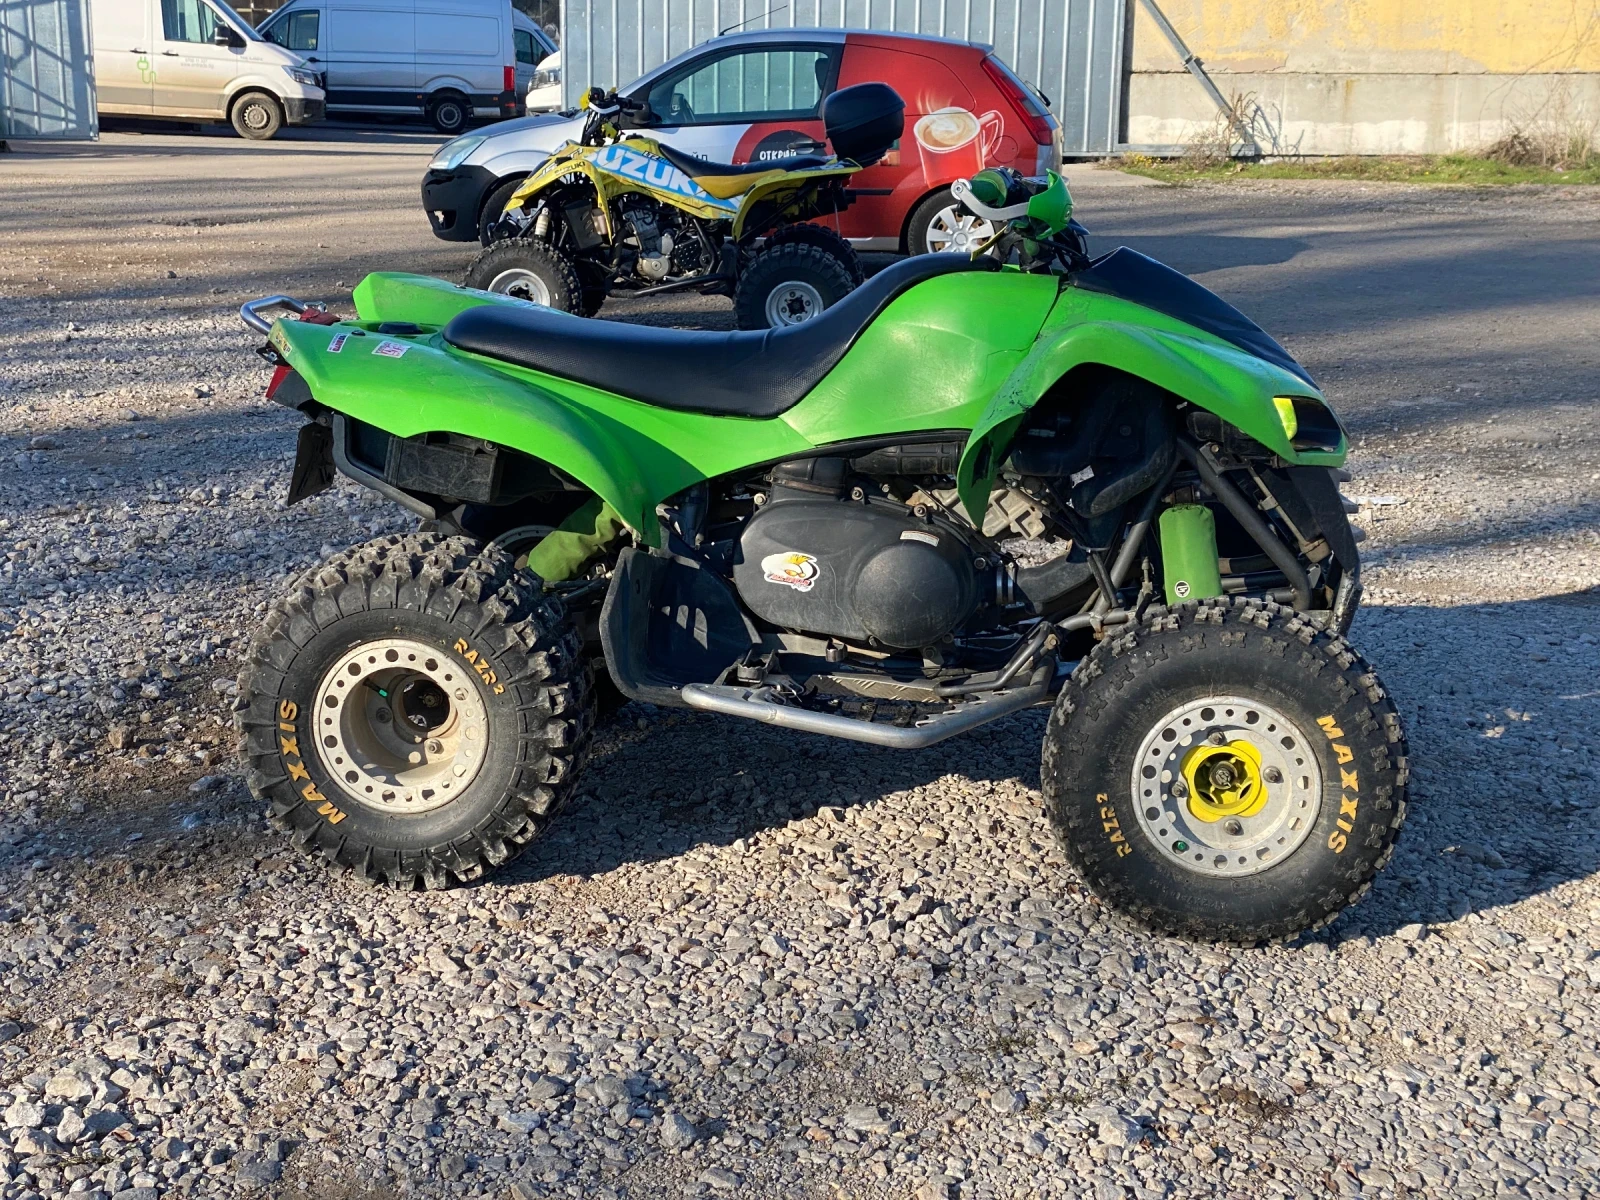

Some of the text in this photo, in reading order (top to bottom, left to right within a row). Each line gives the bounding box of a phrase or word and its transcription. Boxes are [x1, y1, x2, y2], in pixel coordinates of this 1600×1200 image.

[554, 161, 586, 176] SUZUKI
[278, 699, 349, 825] MAXXIS
[1316, 714, 1360, 854] MAXXIS
